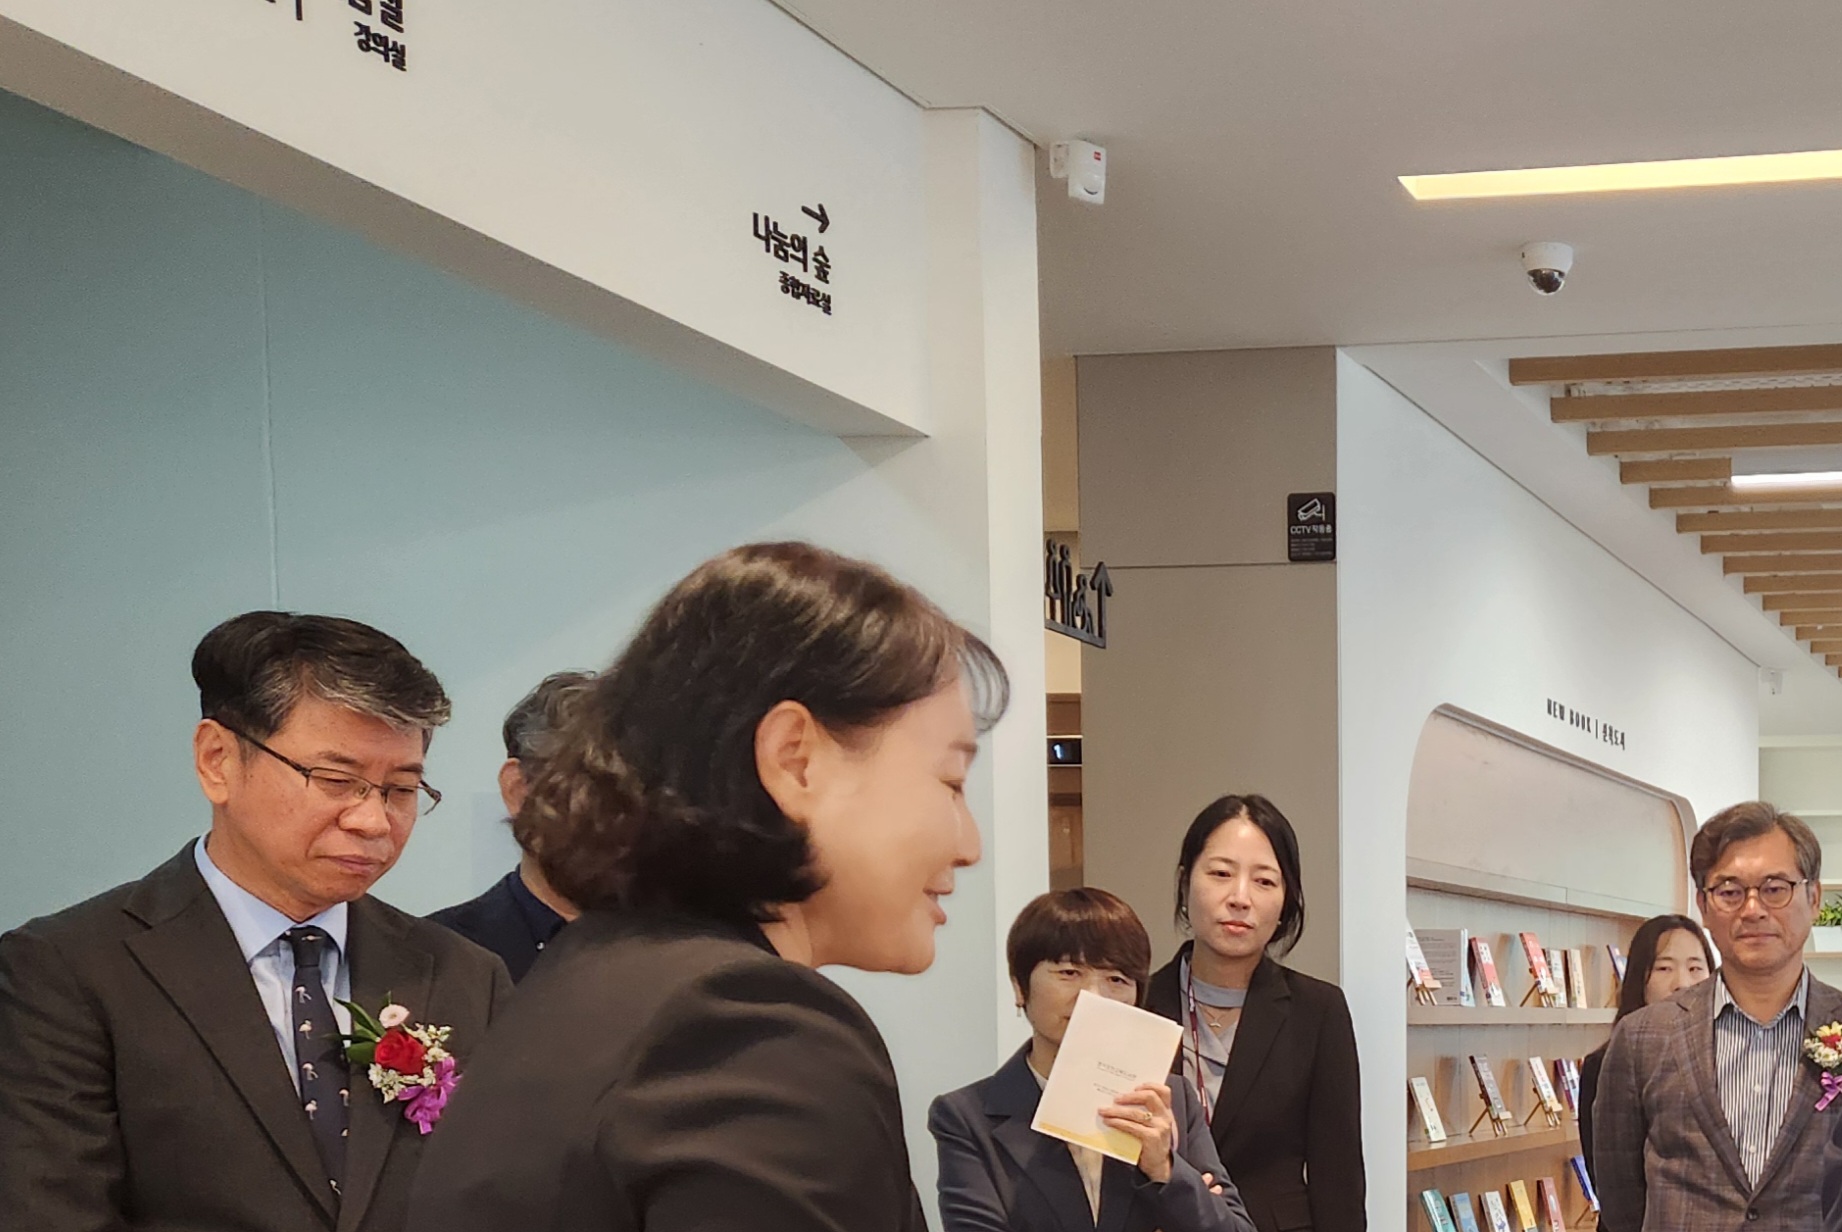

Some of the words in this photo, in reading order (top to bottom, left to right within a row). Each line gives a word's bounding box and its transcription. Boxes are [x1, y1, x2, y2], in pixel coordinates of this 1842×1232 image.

[353, 20, 407, 72] 강의실
[752, 211, 809, 273] 나눔의
[811, 245, 832, 285] 숲
[1546, 697, 1565, 721] NEW
[1569, 708, 1592, 733] BOOK
